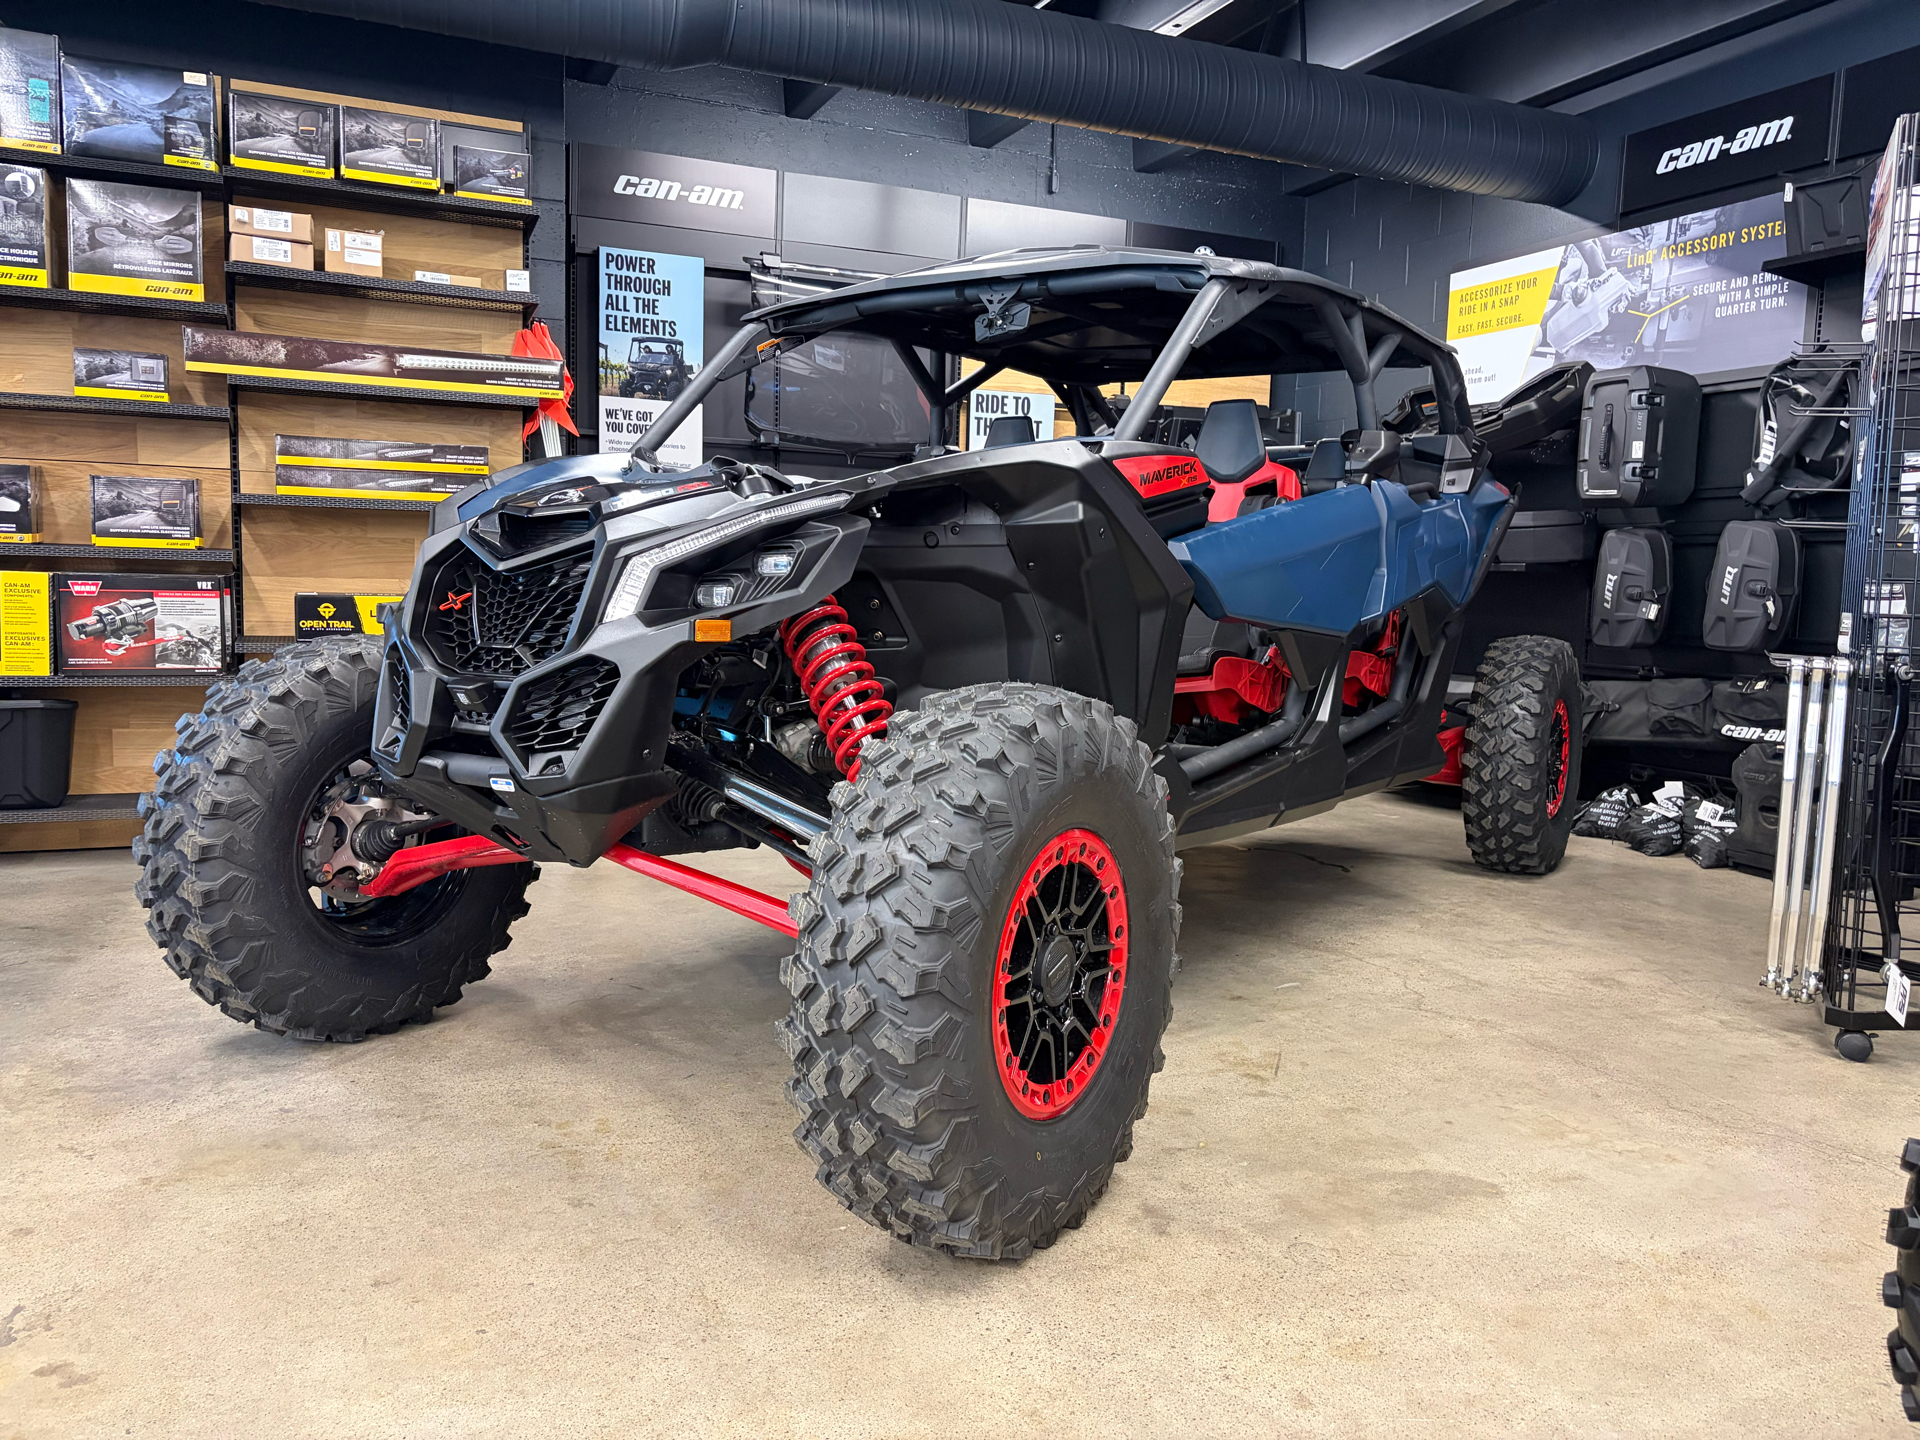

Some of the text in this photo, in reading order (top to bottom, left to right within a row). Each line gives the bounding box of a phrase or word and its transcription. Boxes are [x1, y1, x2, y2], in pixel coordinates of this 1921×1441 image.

[1656, 115, 1794, 175] can-am
[613, 174, 744, 210] can-am
[1660, 231, 1736, 261] ACCESSORY
[606, 252, 656, 275] POWER
[145, 285, 194, 295] can-am
[605, 273, 671, 296] THROUGH
[1460, 277, 1538, 304] ACCESSORIZE YOUR
[1693, 280, 1727, 296] SECURE
[1730, 276, 1748, 289] AND
[1719, 282, 1789, 304] WITH A SIMPLE
[605, 294, 659, 315] ALL THE
[1459, 295, 1520, 317] RIDE IN A SNAP
[1715, 296, 1787, 318] QUARTER TURN.
[605, 314, 677, 337] ELEMENTS
[1458, 314, 1524, 334] EASY. FAST. SECURE.
[1465, 366, 1483, 375] ahead,
[1484, 374, 1496, 382] out!
[605, 408, 653, 422] WE'VE GOT
[976, 394, 1031, 416] RIDE TO
[605, 421, 624, 433] YOU
[1139, 461, 1197, 486] MAVERICK
[299, 620, 355, 628] OPEN TRAIL
